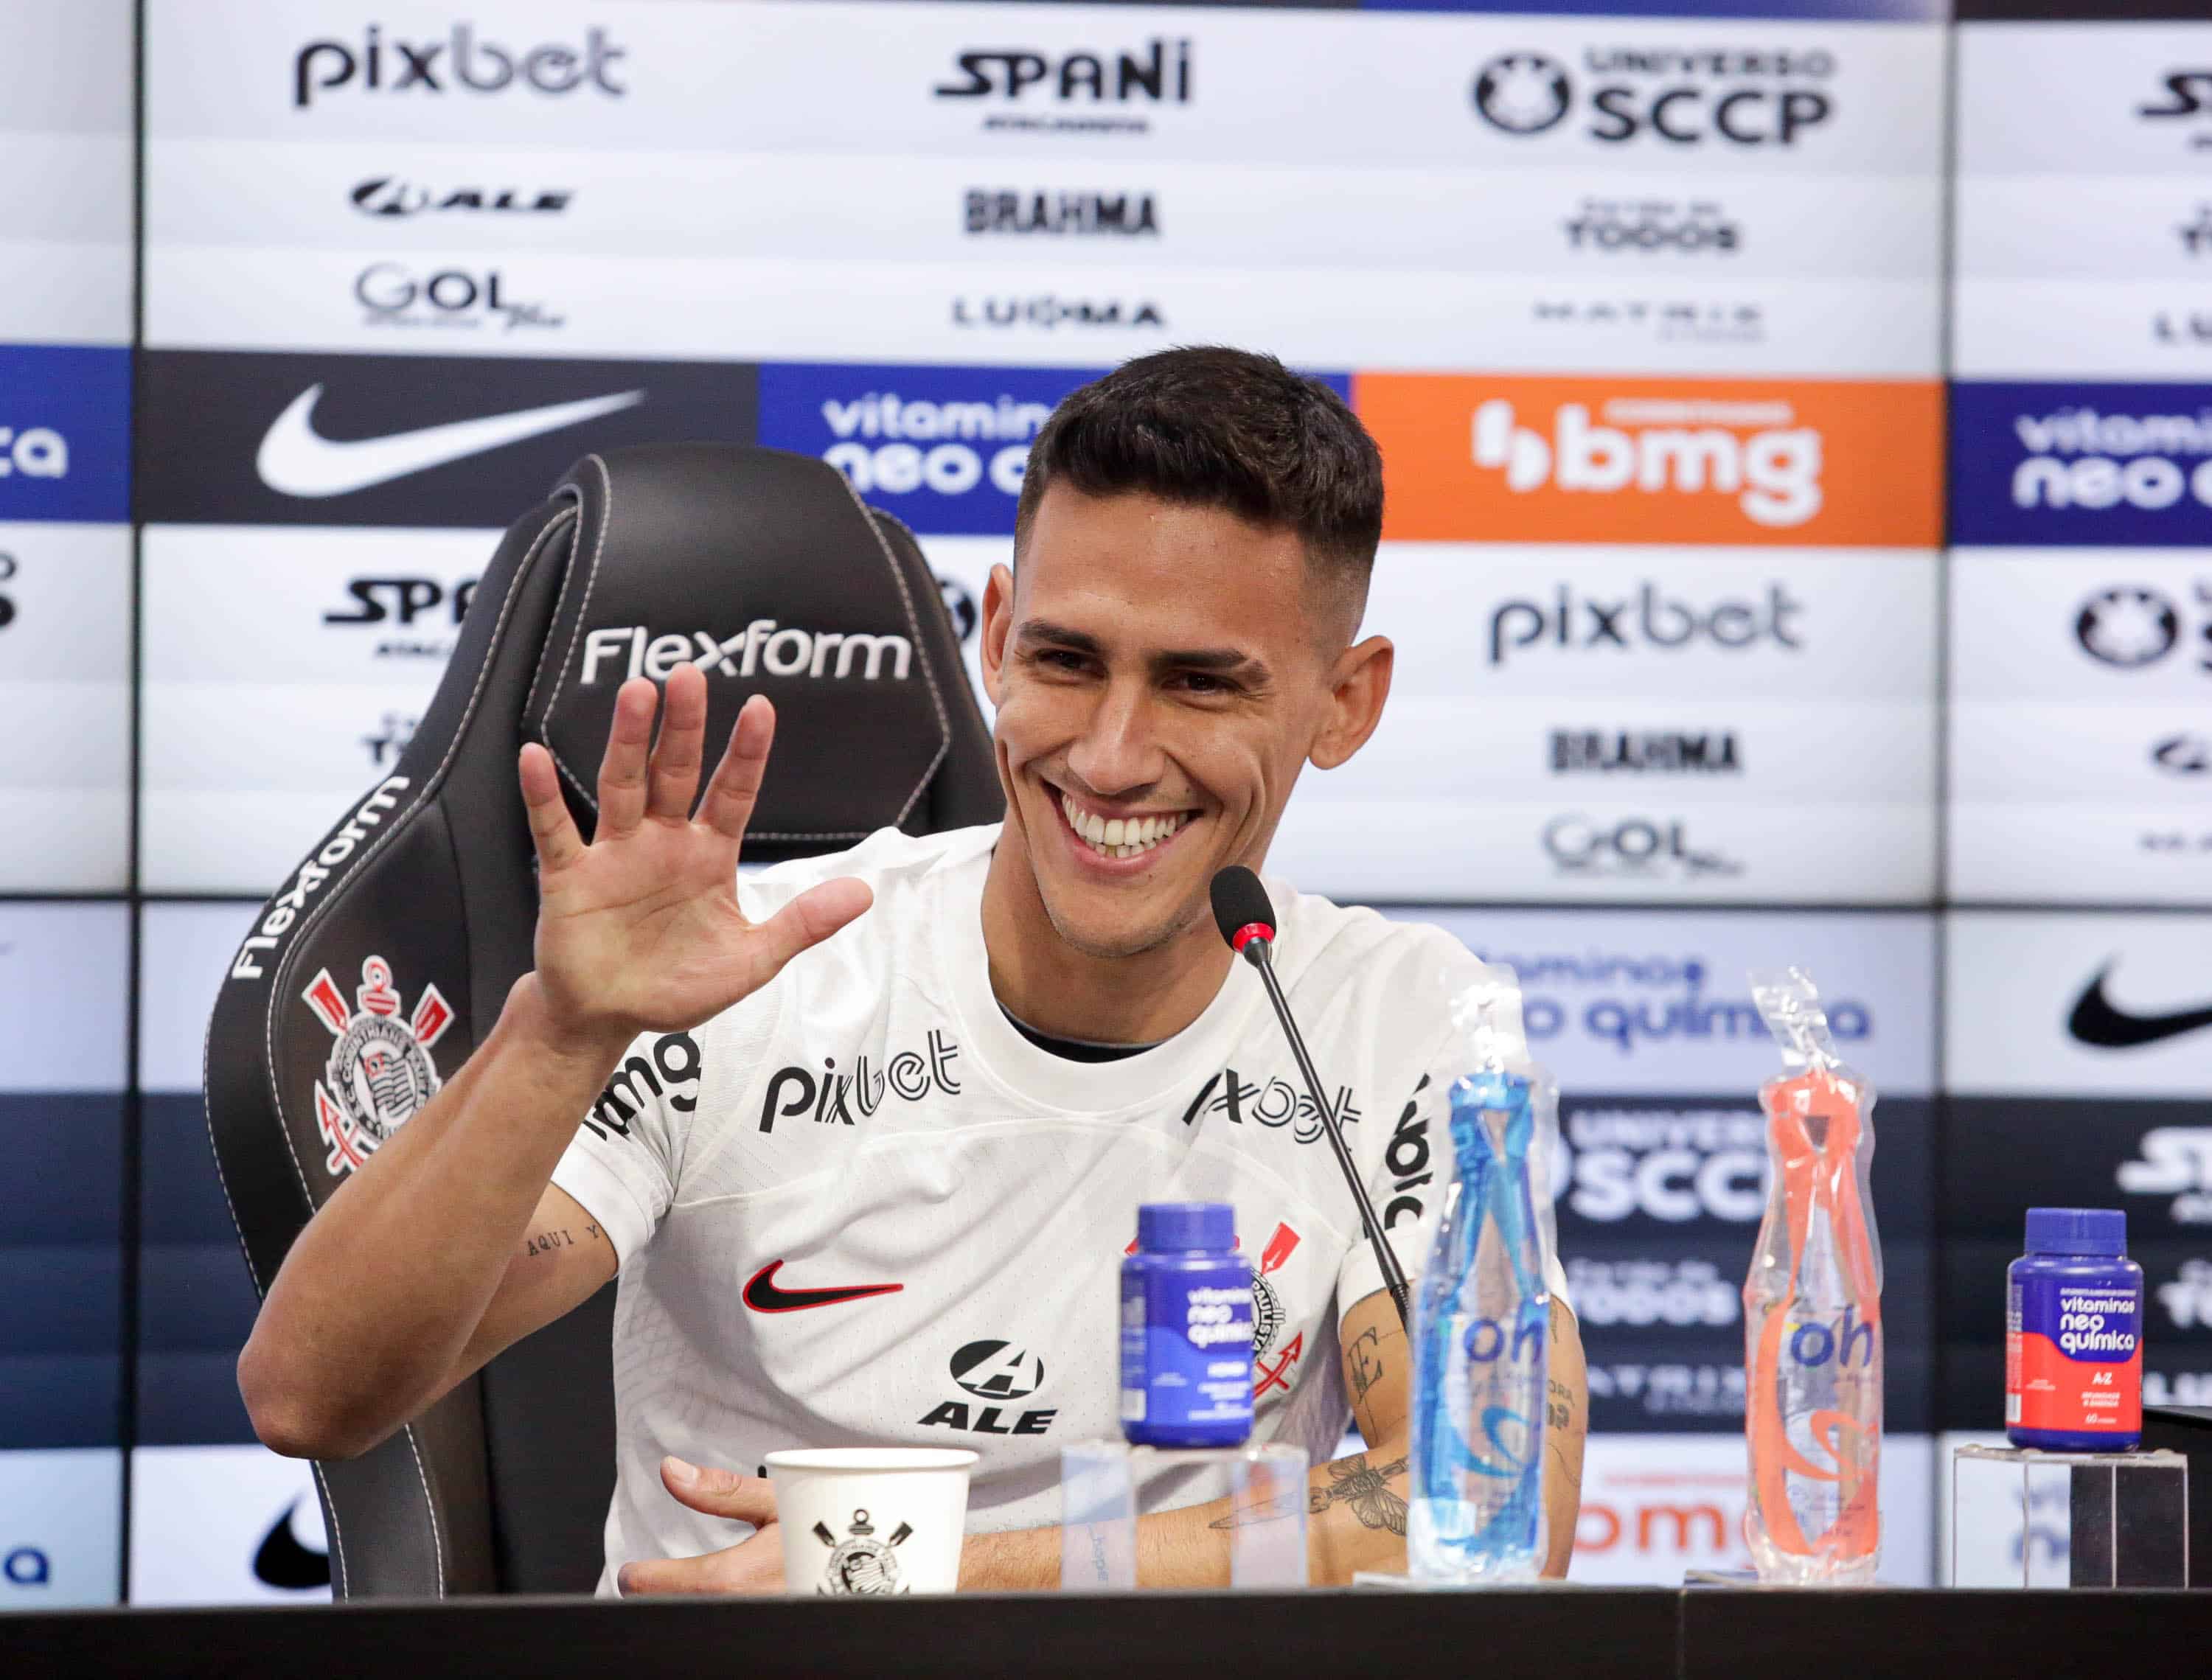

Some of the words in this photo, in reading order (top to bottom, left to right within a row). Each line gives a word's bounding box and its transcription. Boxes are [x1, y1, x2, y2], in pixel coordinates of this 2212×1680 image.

[294, 25, 627, 108] pixbet
[1591, 86, 1832, 144] SCCP
[1555, 402, 1823, 526] bmg
[580, 618, 913, 685] Flexform
[1489, 582, 1805, 665] pixbet
[232, 775, 410, 980] Flexform
[759, 1029, 961, 1133] pixbet
[1571, 1149, 1774, 1221] SCC
[527, 1230, 574, 1257] AQUI
[1464, 1299, 1545, 1363] oh
[1790, 1304, 1875, 1368] oh
[2059, 1313, 2105, 1331] neo
[917, 1401, 1058, 1435] ALE
